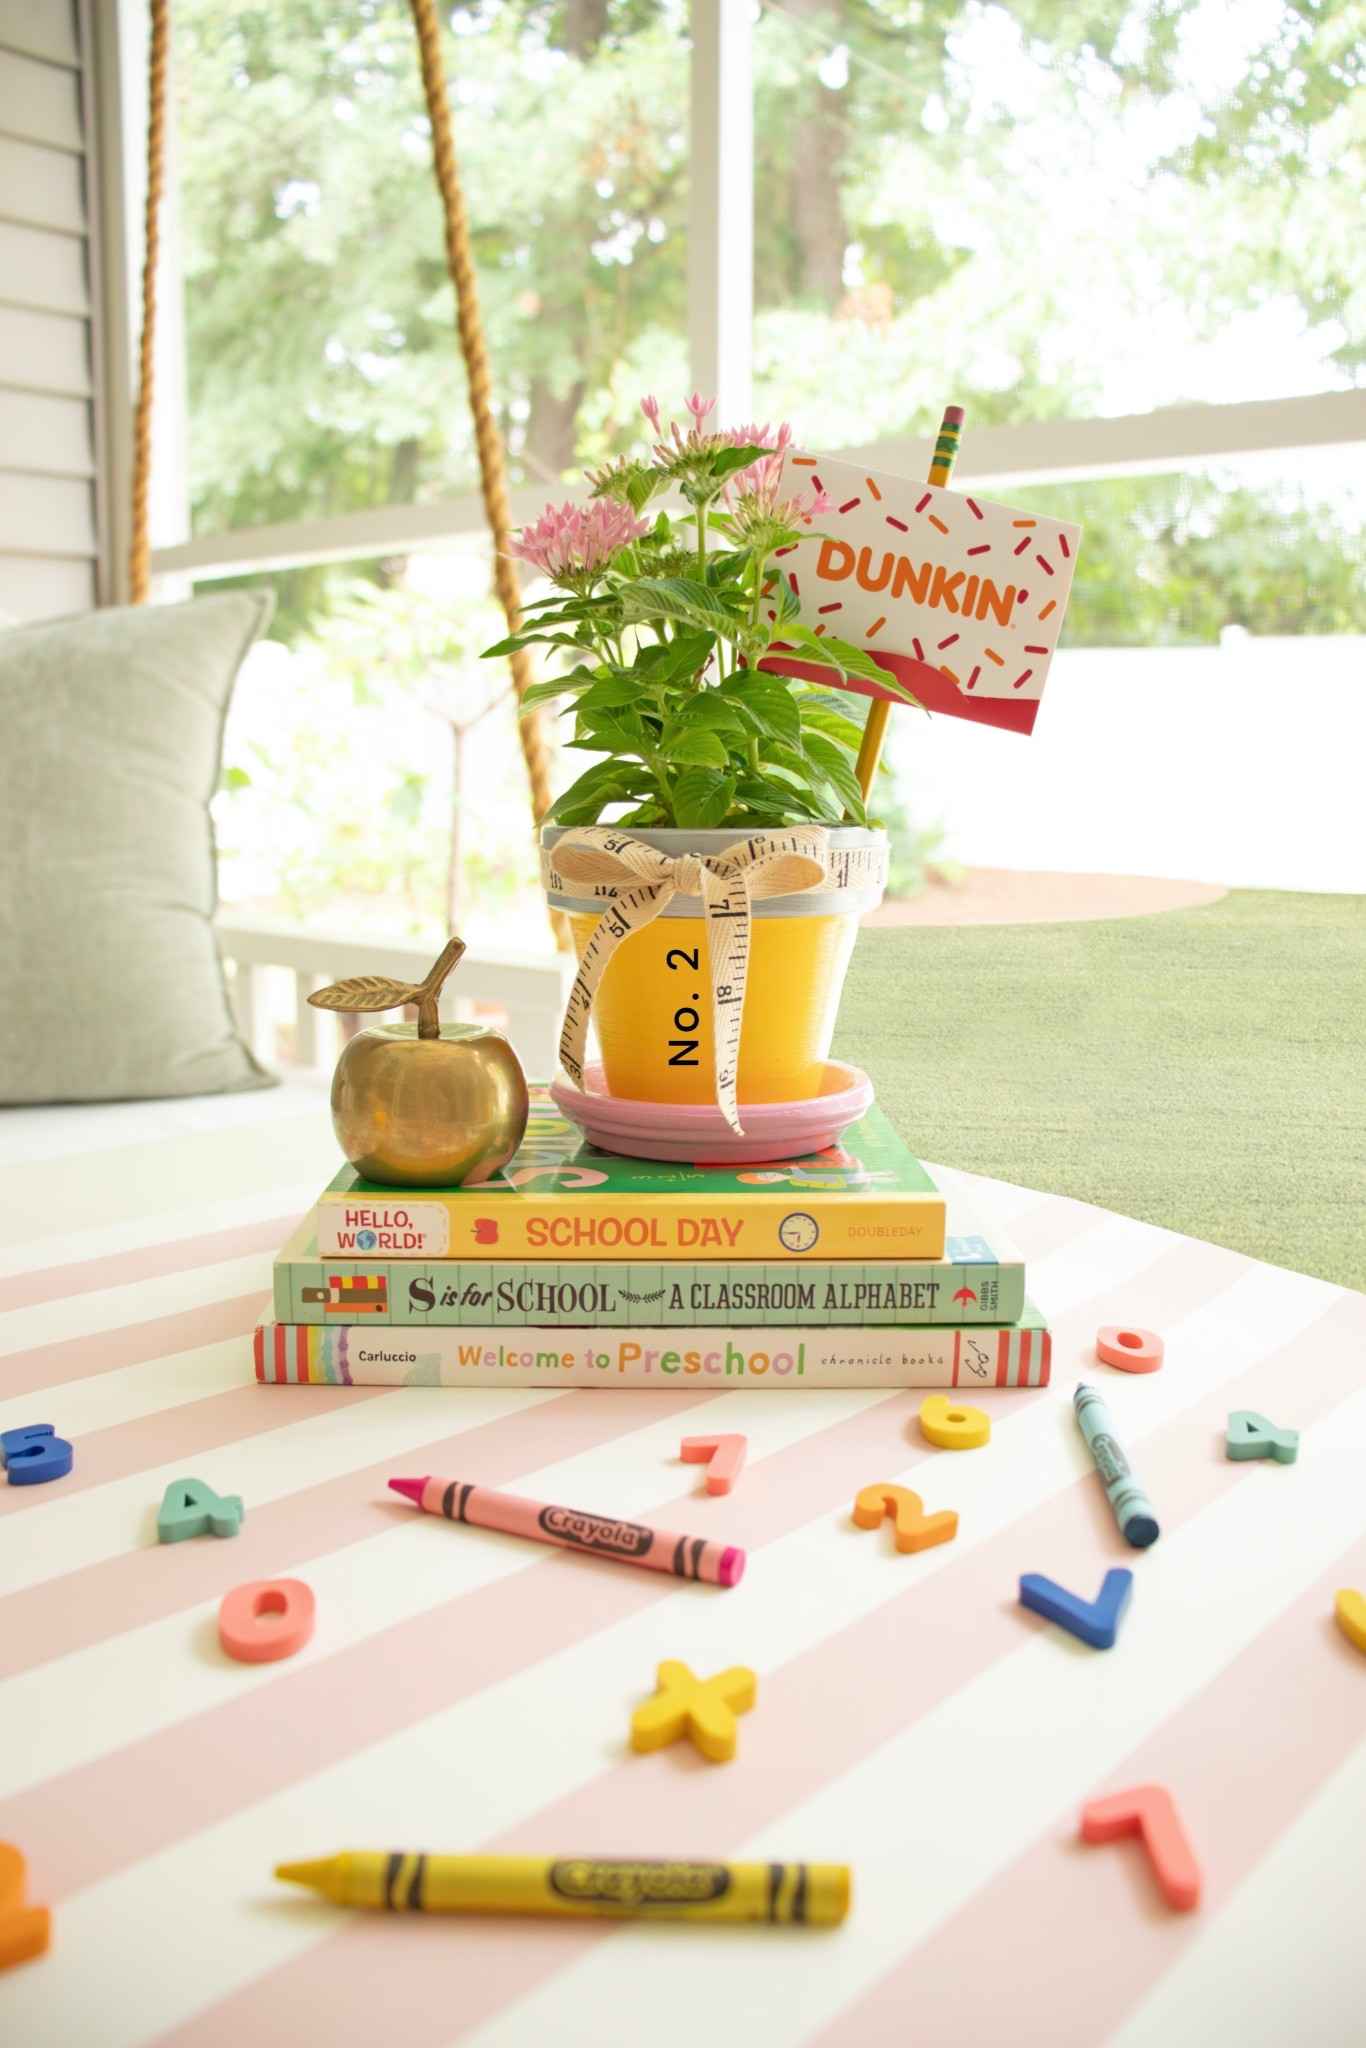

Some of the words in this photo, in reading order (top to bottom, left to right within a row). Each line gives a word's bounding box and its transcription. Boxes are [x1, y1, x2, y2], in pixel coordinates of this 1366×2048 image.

[709, 899, 730, 911] 7
[609, 921, 625, 939] 5
[666, 948, 699, 971] 2
[717, 985, 732, 997] 8
[668, 992, 700, 1066] No.
[345, 1209, 414, 1230] HELLO,
[525, 1216, 668, 1248] SCHOOL
[677, 1217, 744, 1248] DAY
[848, 1226, 923, 1238] DOUBLEDAY
[408, 1276, 436, 1315] S
[497, 1278, 616, 1314] SCHOOL
[668, 1283, 685, 1310] A
[690, 1283, 816, 1310] CLASSROOM
[822, 1282, 940, 1310] ALPHABET
[980, 1280, 989, 1311] GIBBS
[990, 1280, 999, 1311] SMITH
[358, 1350, 417, 1363] Carluccio
[457, 1345, 575, 1368] Welcome
[584, 1349, 610, 1369] to
[618, 1342, 805, 1375] Preschool
[821, 1354, 892, 1366] chronicle
[902, 1354, 944, 1366] books
[546, 1507, 638, 1549] Crayola
